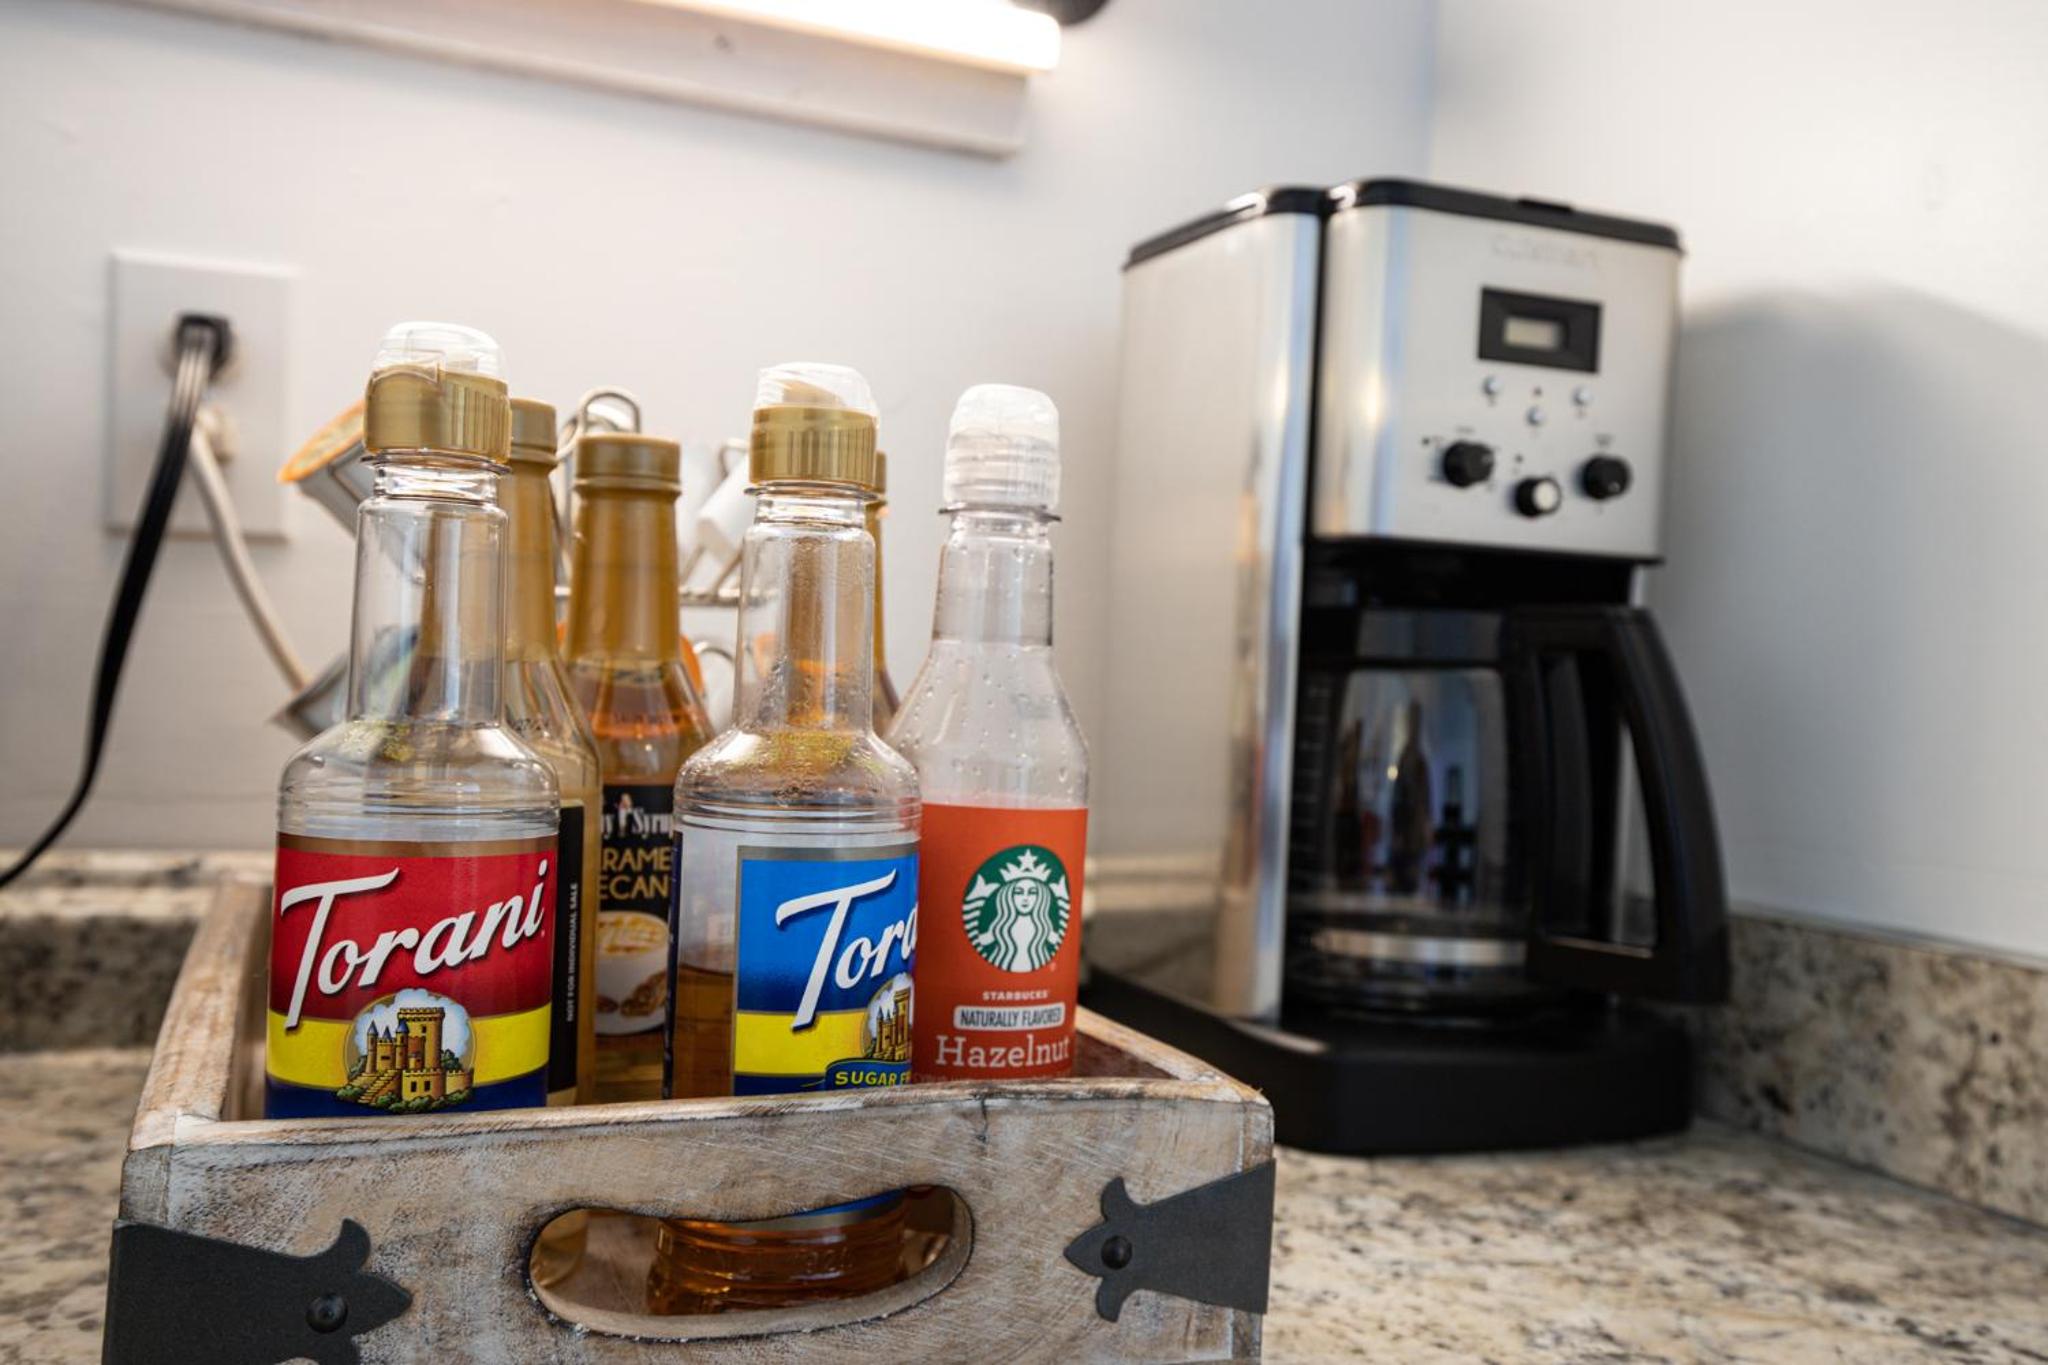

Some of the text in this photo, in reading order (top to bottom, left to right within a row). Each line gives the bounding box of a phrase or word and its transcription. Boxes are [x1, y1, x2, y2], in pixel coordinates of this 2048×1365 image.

[280, 859, 549, 1029] Torani
[566, 883, 579, 1022] NOT FOR INDIVIDUAL SALE
[982, 990, 1049, 1001] STARBUCKS
[960, 1006, 1062, 1028] NATURALLY FLAVORED
[935, 1033, 1071, 1068] Hazelnut
[834, 1070, 898, 1088] SUGAR
